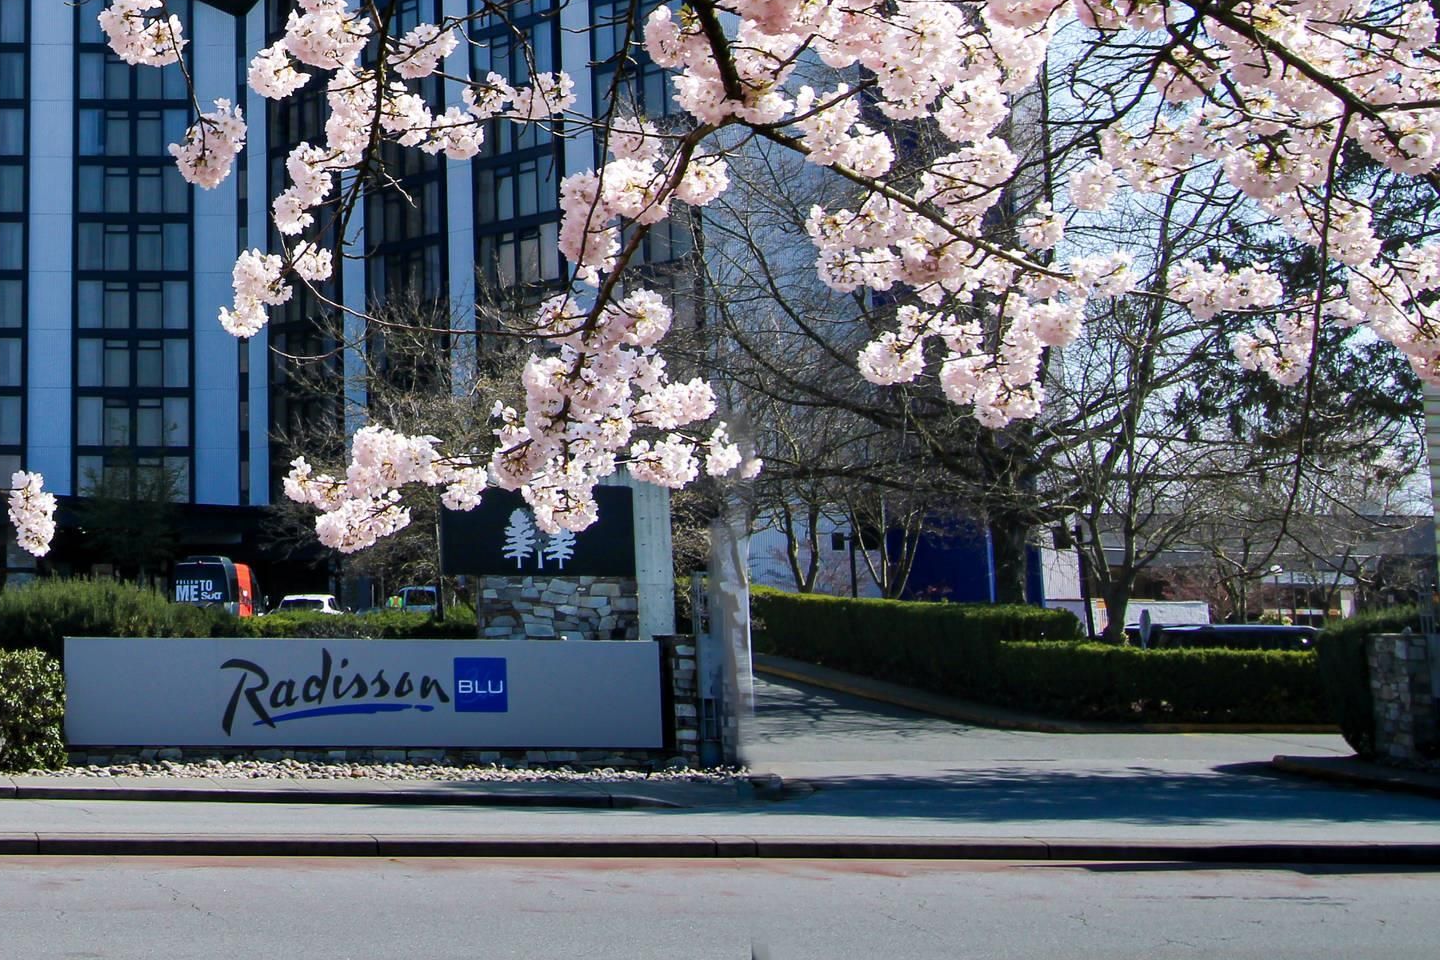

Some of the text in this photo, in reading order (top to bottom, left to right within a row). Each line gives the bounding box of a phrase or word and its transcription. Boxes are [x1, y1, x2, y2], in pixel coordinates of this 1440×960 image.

[175, 585, 199, 602] ME
[200, 579, 213, 591] TO
[220, 647, 504, 737] Radisson BLU
